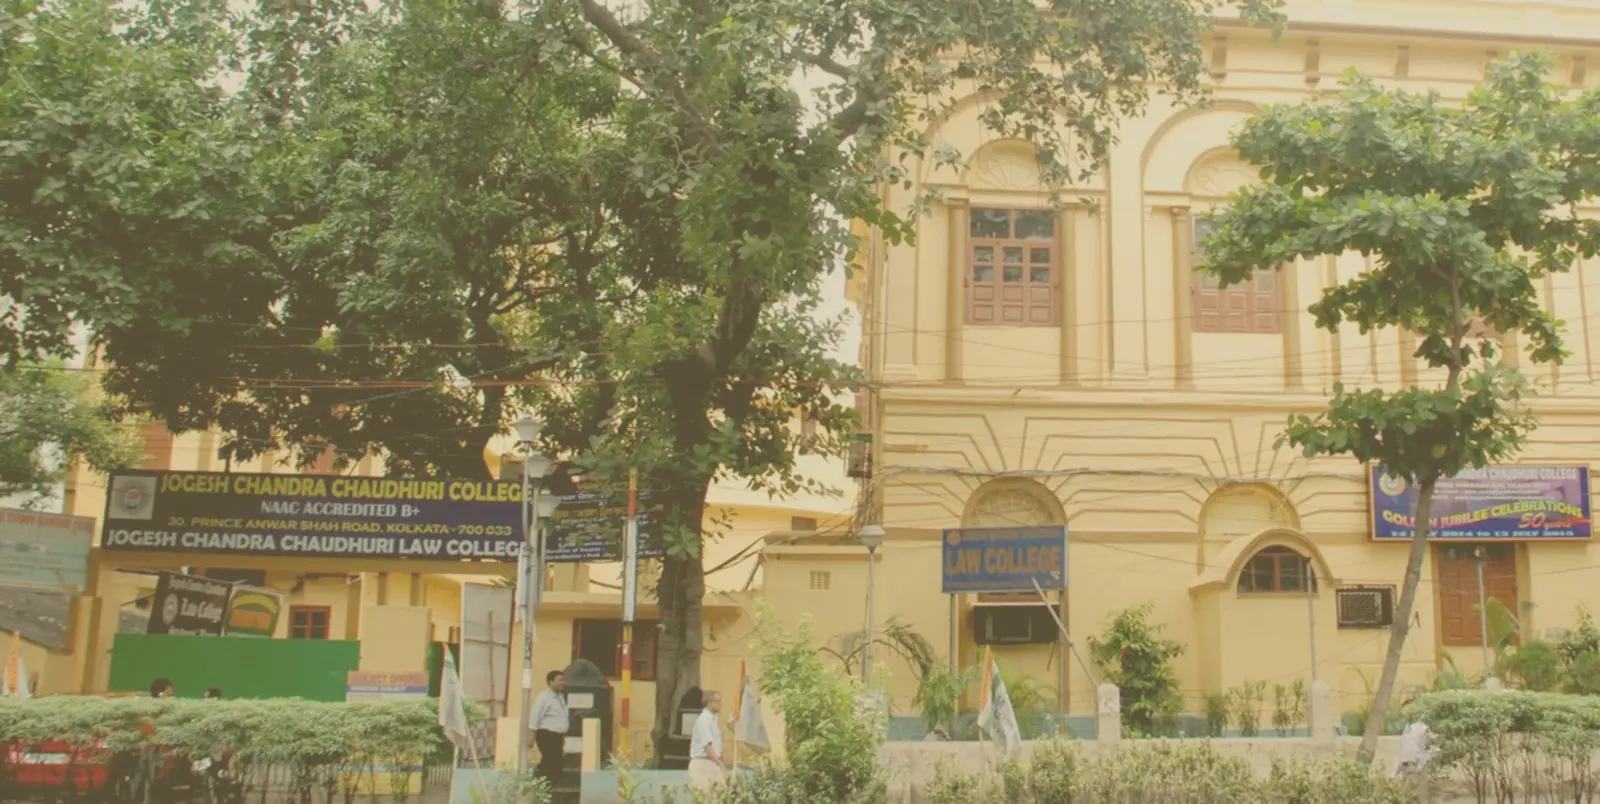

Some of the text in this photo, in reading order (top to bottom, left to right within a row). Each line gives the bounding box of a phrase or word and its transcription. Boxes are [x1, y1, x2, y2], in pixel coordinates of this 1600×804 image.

[1540, 466, 1578, 480] COLLEGE
[161, 474, 228, 494] JOGESH
[233, 477, 326, 497] CHANDRA
[331, 479, 445, 501] CHAUDHURI
[260, 500, 421, 518] NAAC ACCREDITED B+
[1440, 507, 1489, 529] JUBILEE
[1490, 499, 1584, 519] CELEBRATIONS
[190, 517, 243, 529] PRINCE
[245, 518, 299, 531] ANWAR
[300, 520, 339, 533] SHAH
[386, 523, 450, 535] KOLKATA
[1518, 512, 1546, 529] 50
[107, 530, 178, 548] JOGESH
[181, 532, 277, 550] CHANDRA
[280, 534, 395, 555] CHAUDHURI
[399, 538, 443, 555] LAW
[946, 545, 1061, 574] LAW COLLEGE
